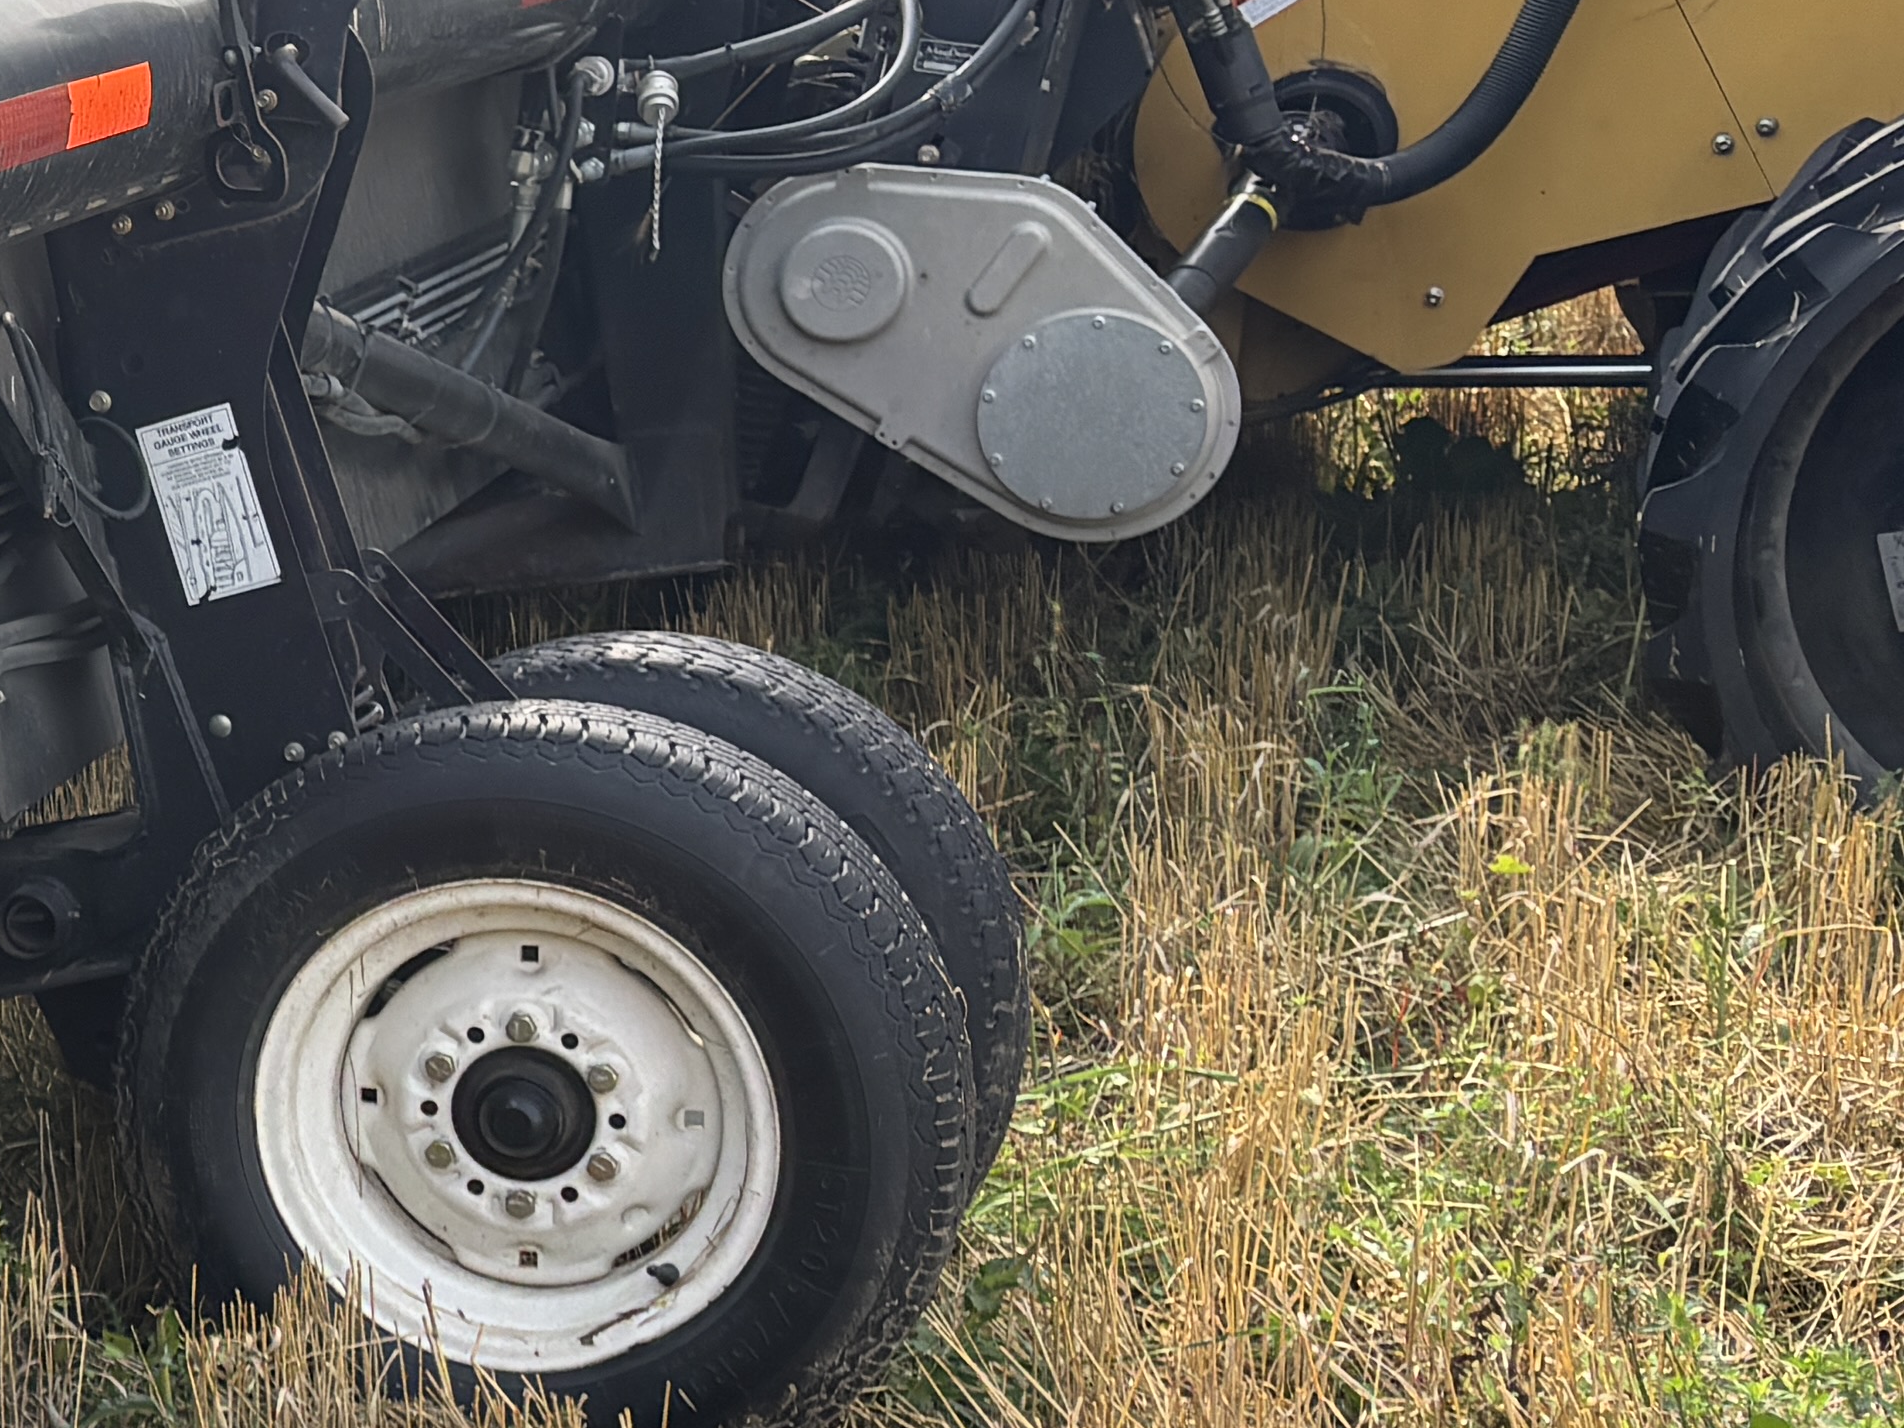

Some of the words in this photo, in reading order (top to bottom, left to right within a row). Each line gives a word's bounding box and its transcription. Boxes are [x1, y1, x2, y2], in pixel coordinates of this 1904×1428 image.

[153, 432, 189, 451] GAUGE
[187, 423, 224, 441] WHEEL
[156, 414, 213, 438] TRANSPORT
[167, 438, 215, 458] SETTINGS
